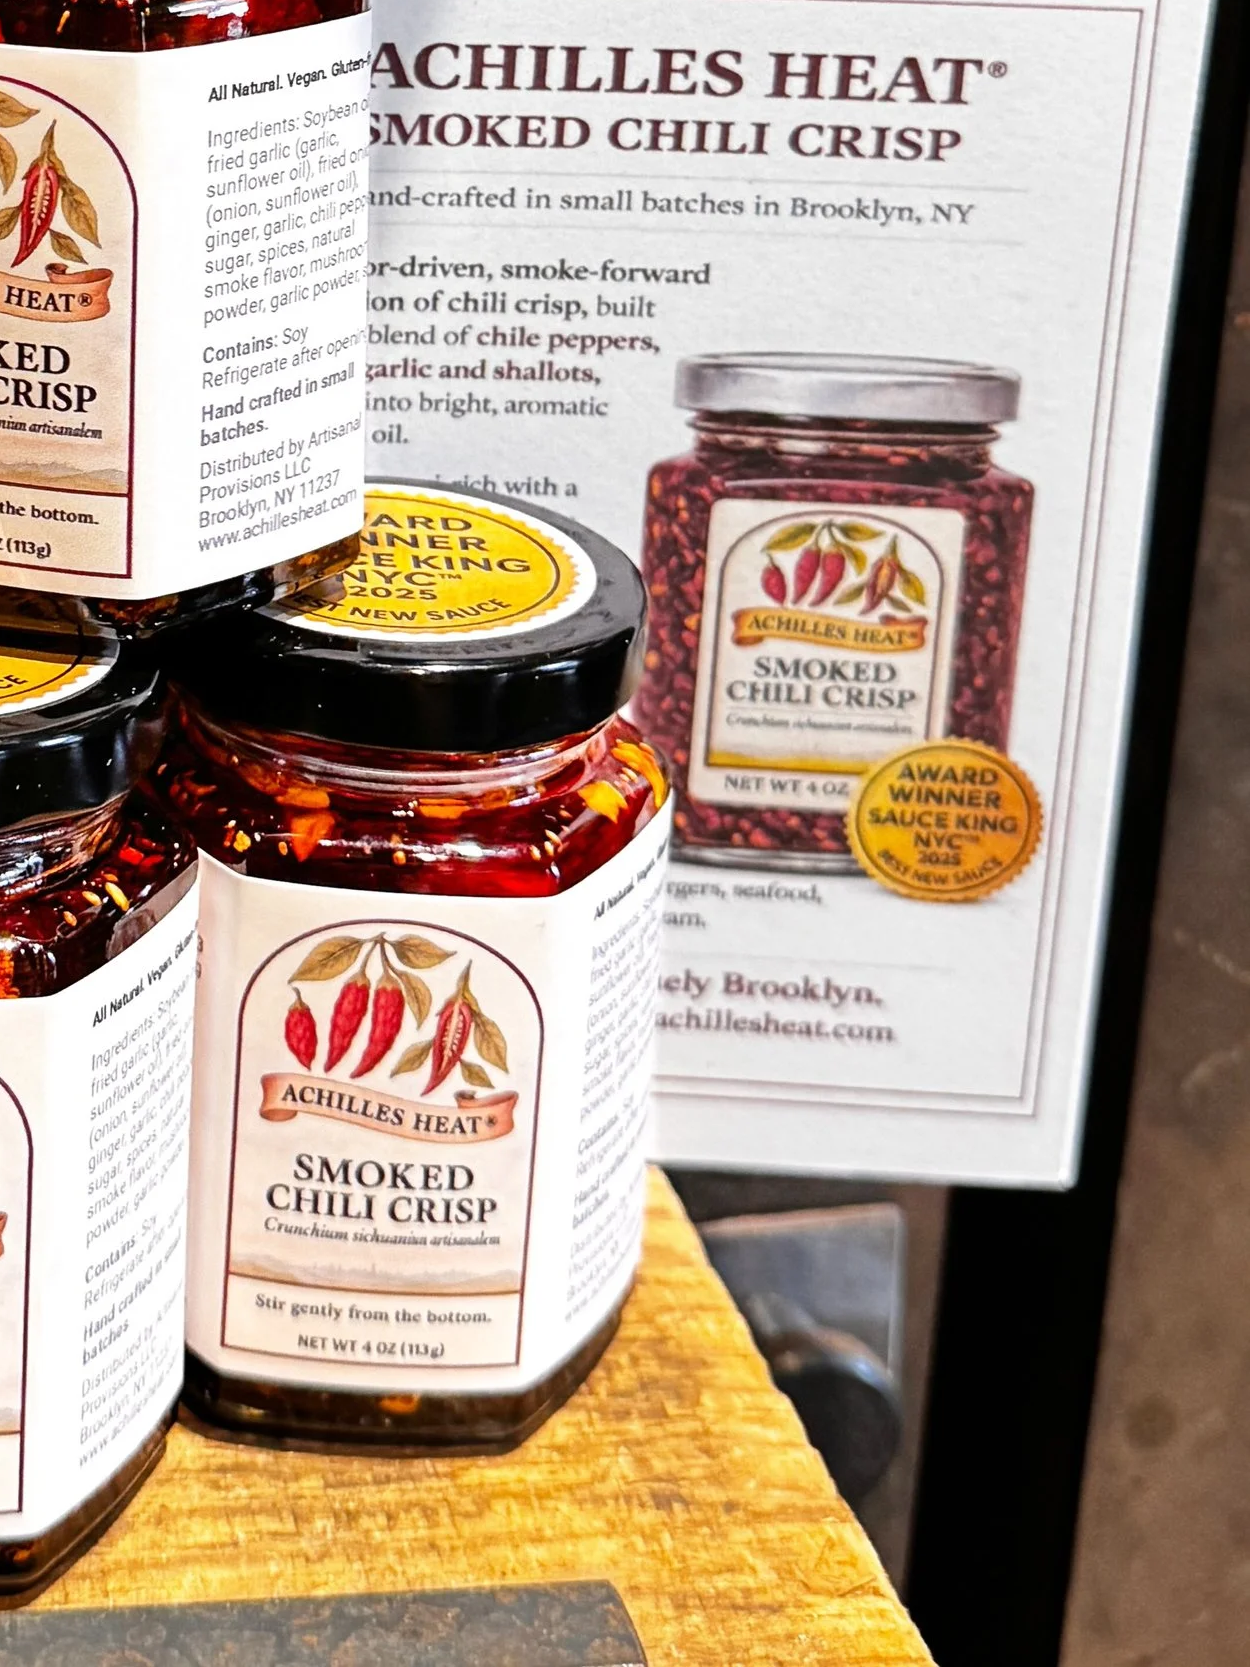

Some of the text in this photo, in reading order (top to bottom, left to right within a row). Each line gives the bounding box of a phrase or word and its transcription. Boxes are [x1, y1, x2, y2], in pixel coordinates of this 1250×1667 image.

[208, 69, 327, 102] All Natural. Vegan.
[370, 42, 744, 98] ACHILLES
[208, 102, 358, 149] Ingredients: Soybean
[608, 117, 771, 155] CHILI
[788, 122, 963, 162] CRISP
[208, 132, 340, 173] fried garlic (garlic,
[207, 170, 285, 198] sunflower
[206, 182, 334, 228] (onion, sunflower
[525, 188, 974, 226] in small batches in Brooklyn, NY
[205, 201, 336, 252] ginger, garlic, chili
[205, 219, 355, 274] sugar, spices, natural
[204, 264, 306, 298] smoke flavor,
[501, 259, 711, 285] smoke-forward
[204, 298, 266, 328] powder,
[270, 285, 309, 312] garlic
[414, 291, 656, 320] of chili crisp, built
[203, 326, 308, 363] Contains: Soy
[368, 326, 660, 354] blend of chile peppers,
[202, 346, 323, 389] Refrigerate after
[439, 360, 486, 380] and
[493, 361, 601, 384] shallots,
[202, 362, 354, 422] Hand crafted in small
[365, 392, 608, 418] into bright, aromatic
[201, 419, 268, 446] batches.
[201, 411, 362, 479] Distributed by Artisanal
[372, 425, 409, 444] oil.
[200, 457, 311, 503] Provisions LLC
[0, 501, 25, 516] the
[31, 505, 99, 525] bottom.
[200, 469, 340, 528] Brooklyn, NY 11237
[198, 488, 357, 552] www.achillesheat.com
[7, 539, 51, 557] (113g)
[413, 555, 530, 573] KING
[350, 585, 437, 600] 2025
[350, 598, 512, 620] NEW SAUCE
[753, 656, 897, 682] SMOKED
[727, 681, 915, 709] CHILI CRISP
[897, 763, 998, 785] AWARD
[888, 784, 1000, 809] WINNER
[868, 808, 1018, 833] SAUCE KING
[733, 882, 822, 904] seafood,
[282, 1084, 405, 1126] ACHILLES
[293, 1153, 474, 1191] SMOKED
[266, 1184, 497, 1223] CHILI CRISP
